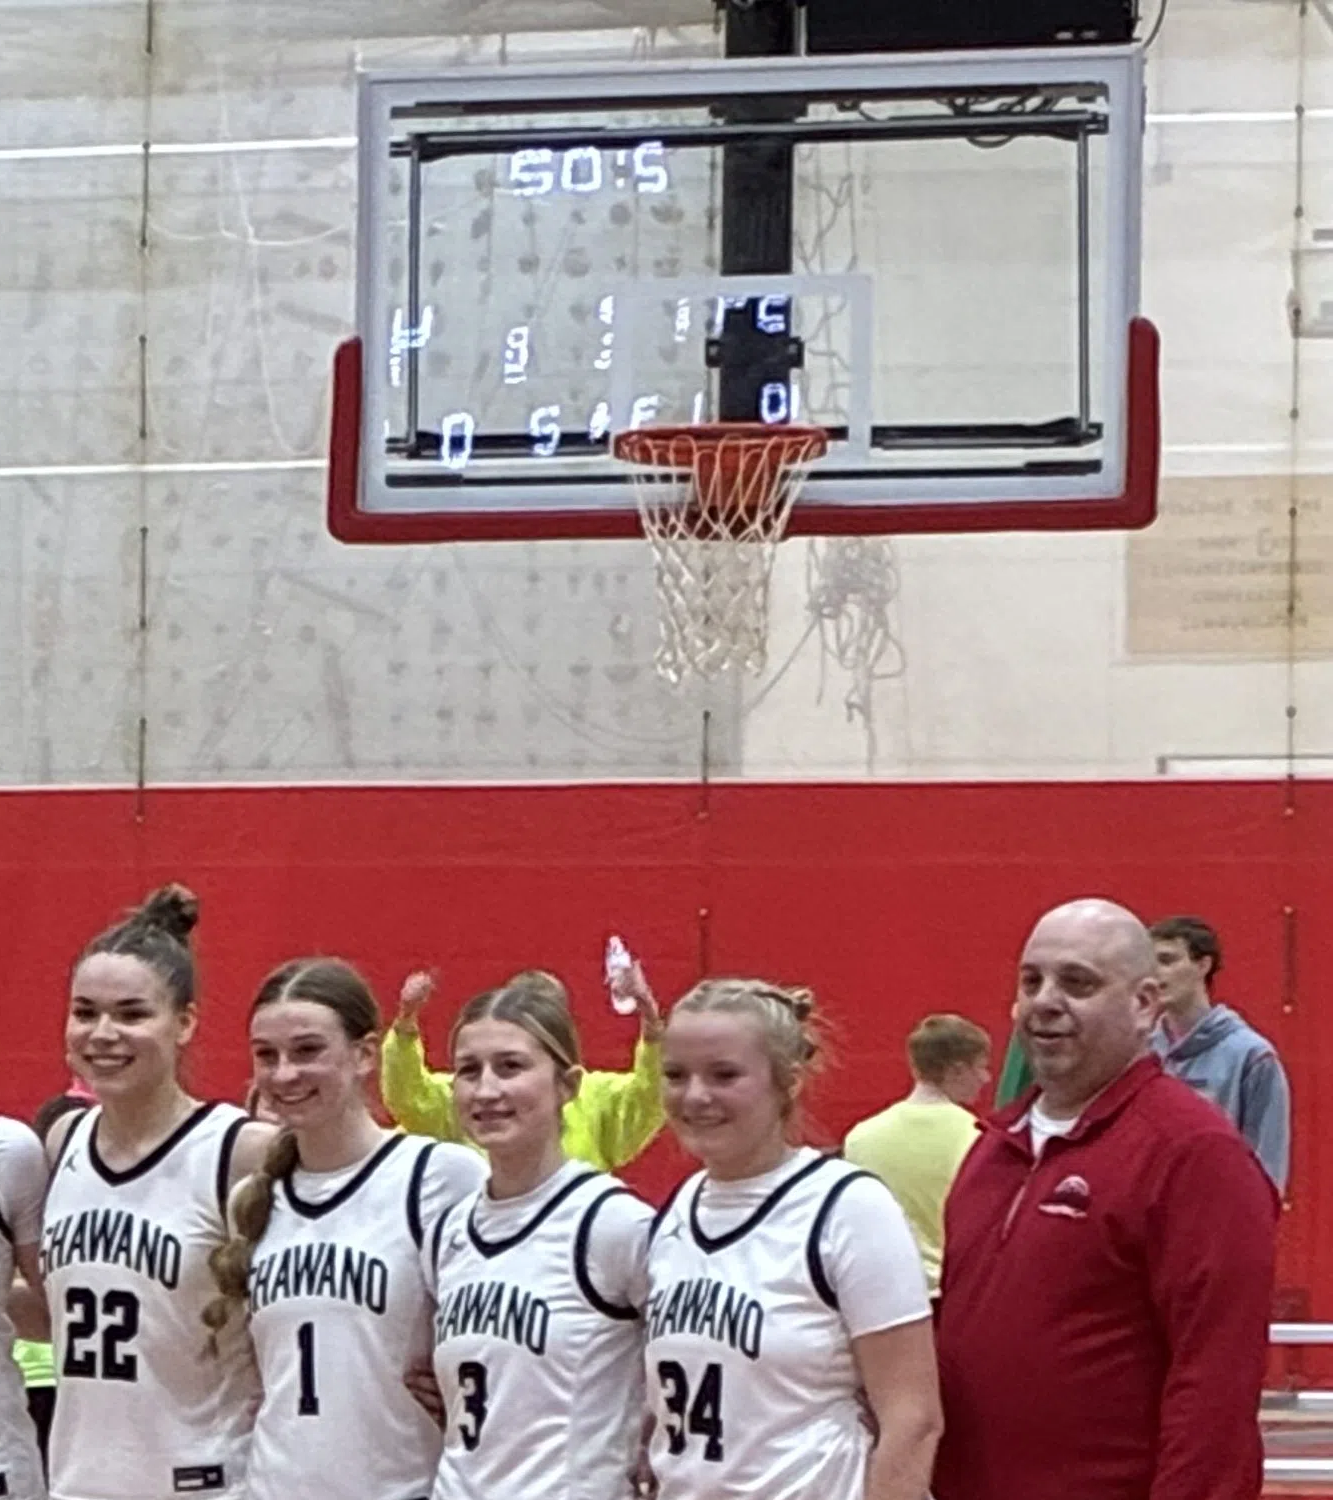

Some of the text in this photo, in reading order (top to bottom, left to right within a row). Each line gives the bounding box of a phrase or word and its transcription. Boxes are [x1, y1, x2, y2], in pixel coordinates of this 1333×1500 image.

[250, 1242, 389, 1315] HAWANO
[646, 1277, 765, 1360] HAWANO
[62, 1286, 140, 1382] 22
[297, 1321, 320, 1416] 1
[458, 1361, 488, 1452] 3
[657, 1360, 724, 1462] 34
